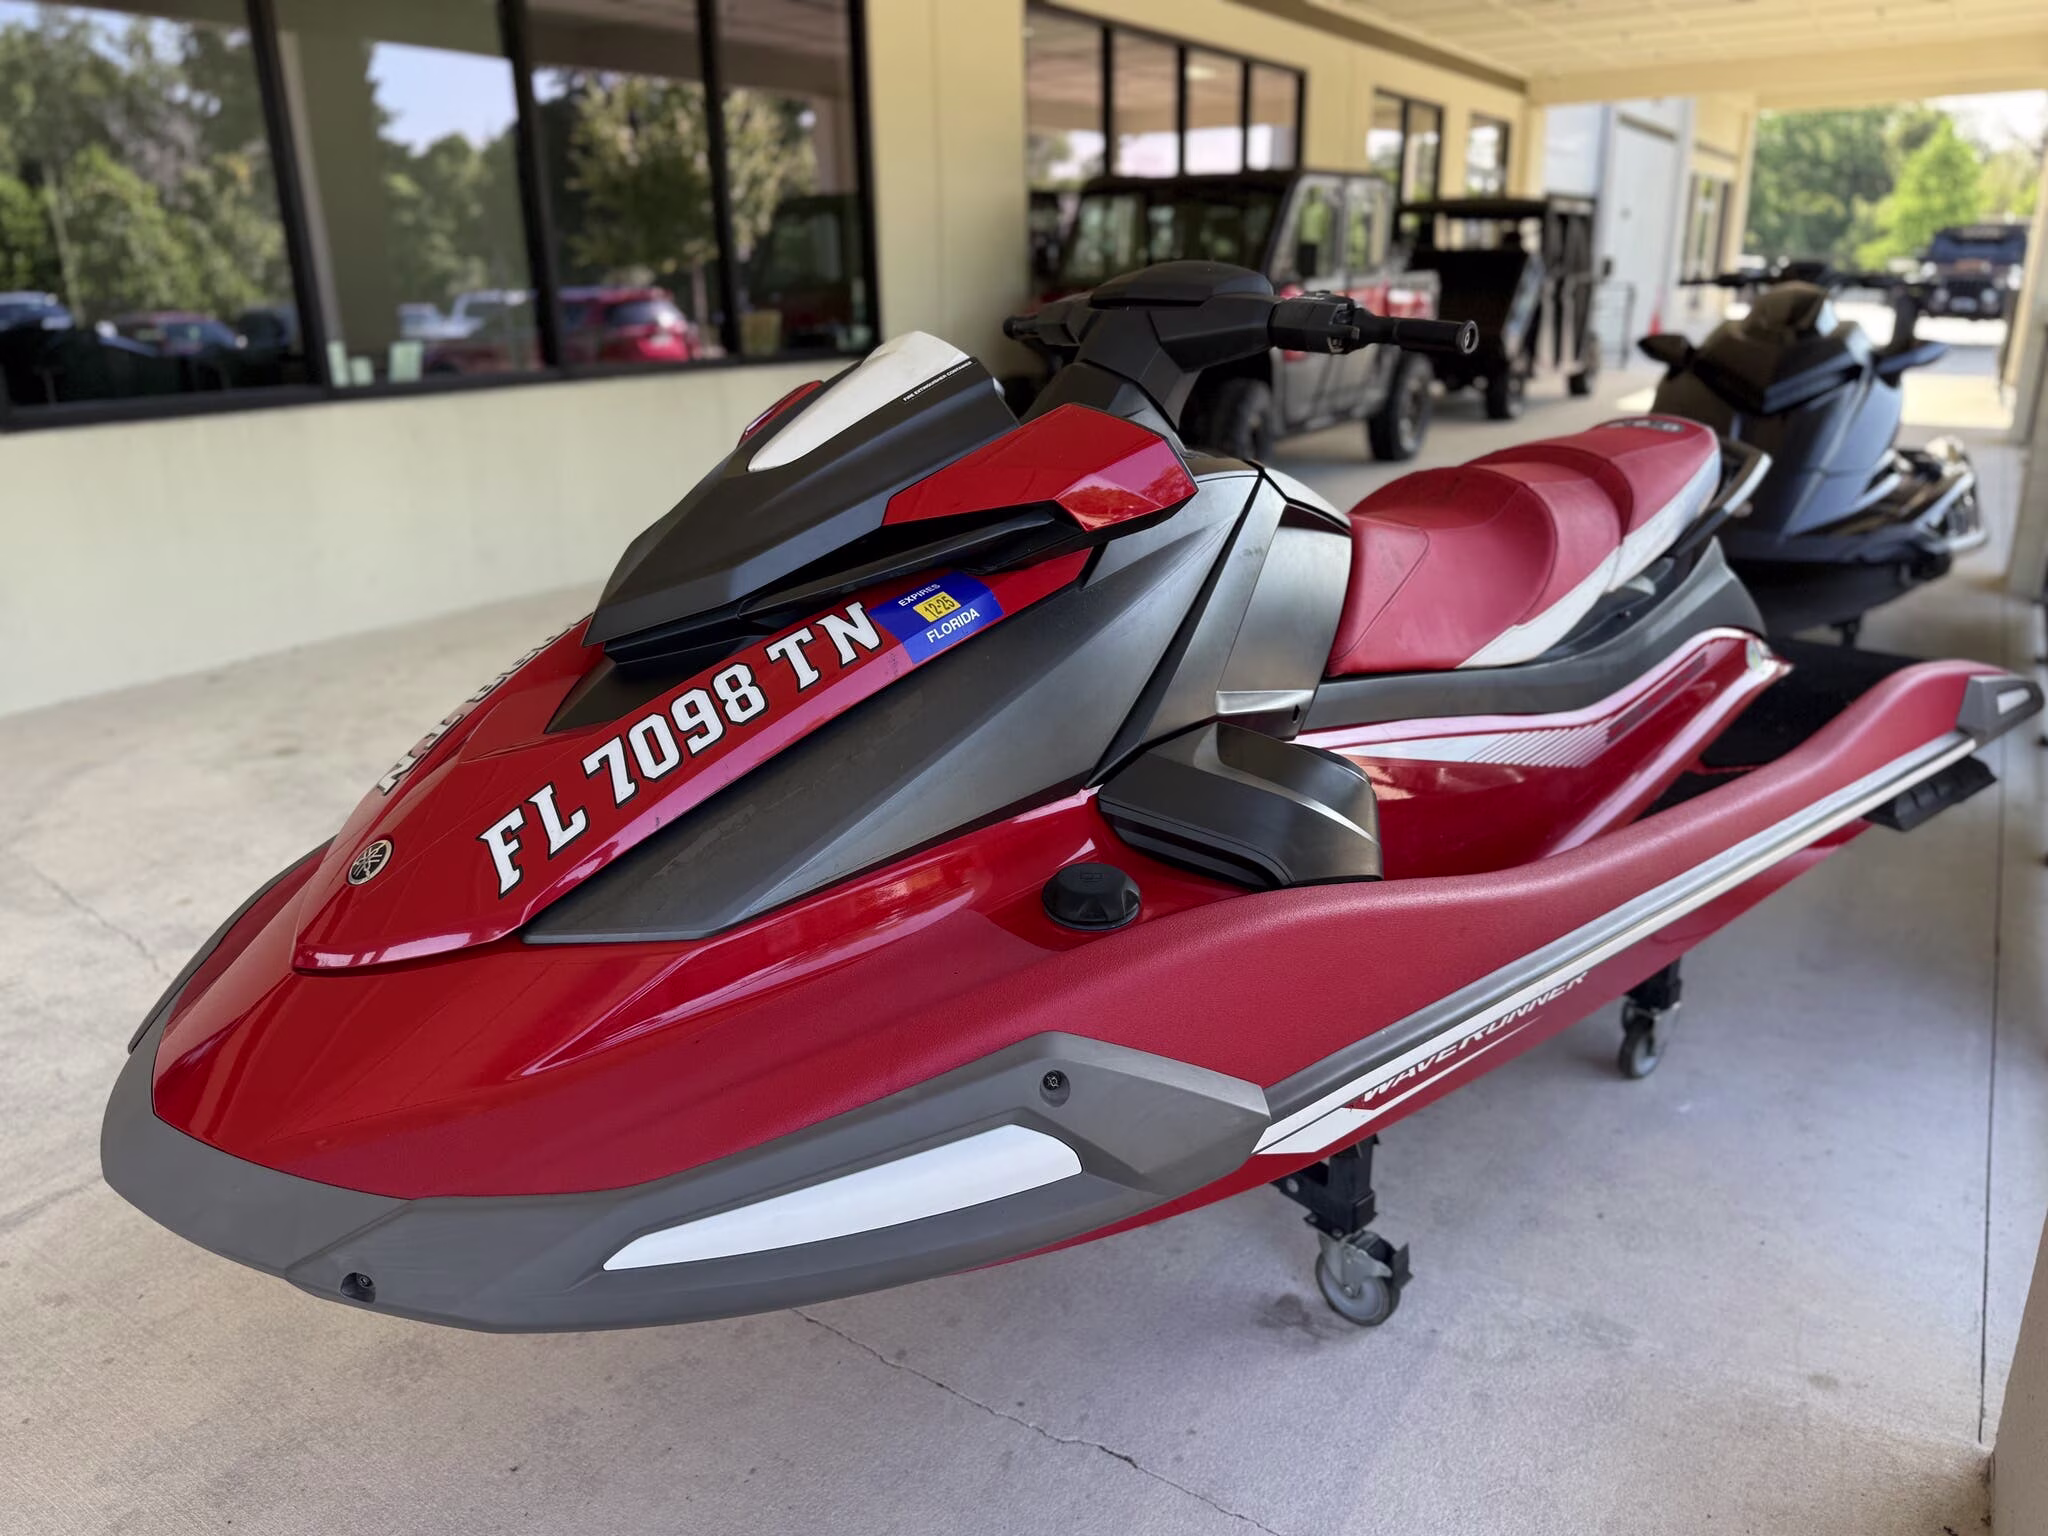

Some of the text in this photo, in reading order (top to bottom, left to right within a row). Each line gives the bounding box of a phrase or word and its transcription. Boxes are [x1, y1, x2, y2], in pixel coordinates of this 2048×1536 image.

[898, 584, 941, 607] EXPIRES
[926, 608, 980, 643] FLORIDA
[478, 601, 883, 899] FL 7098 TN
[1363, 971, 1588, 1102] WAVERUNNER
